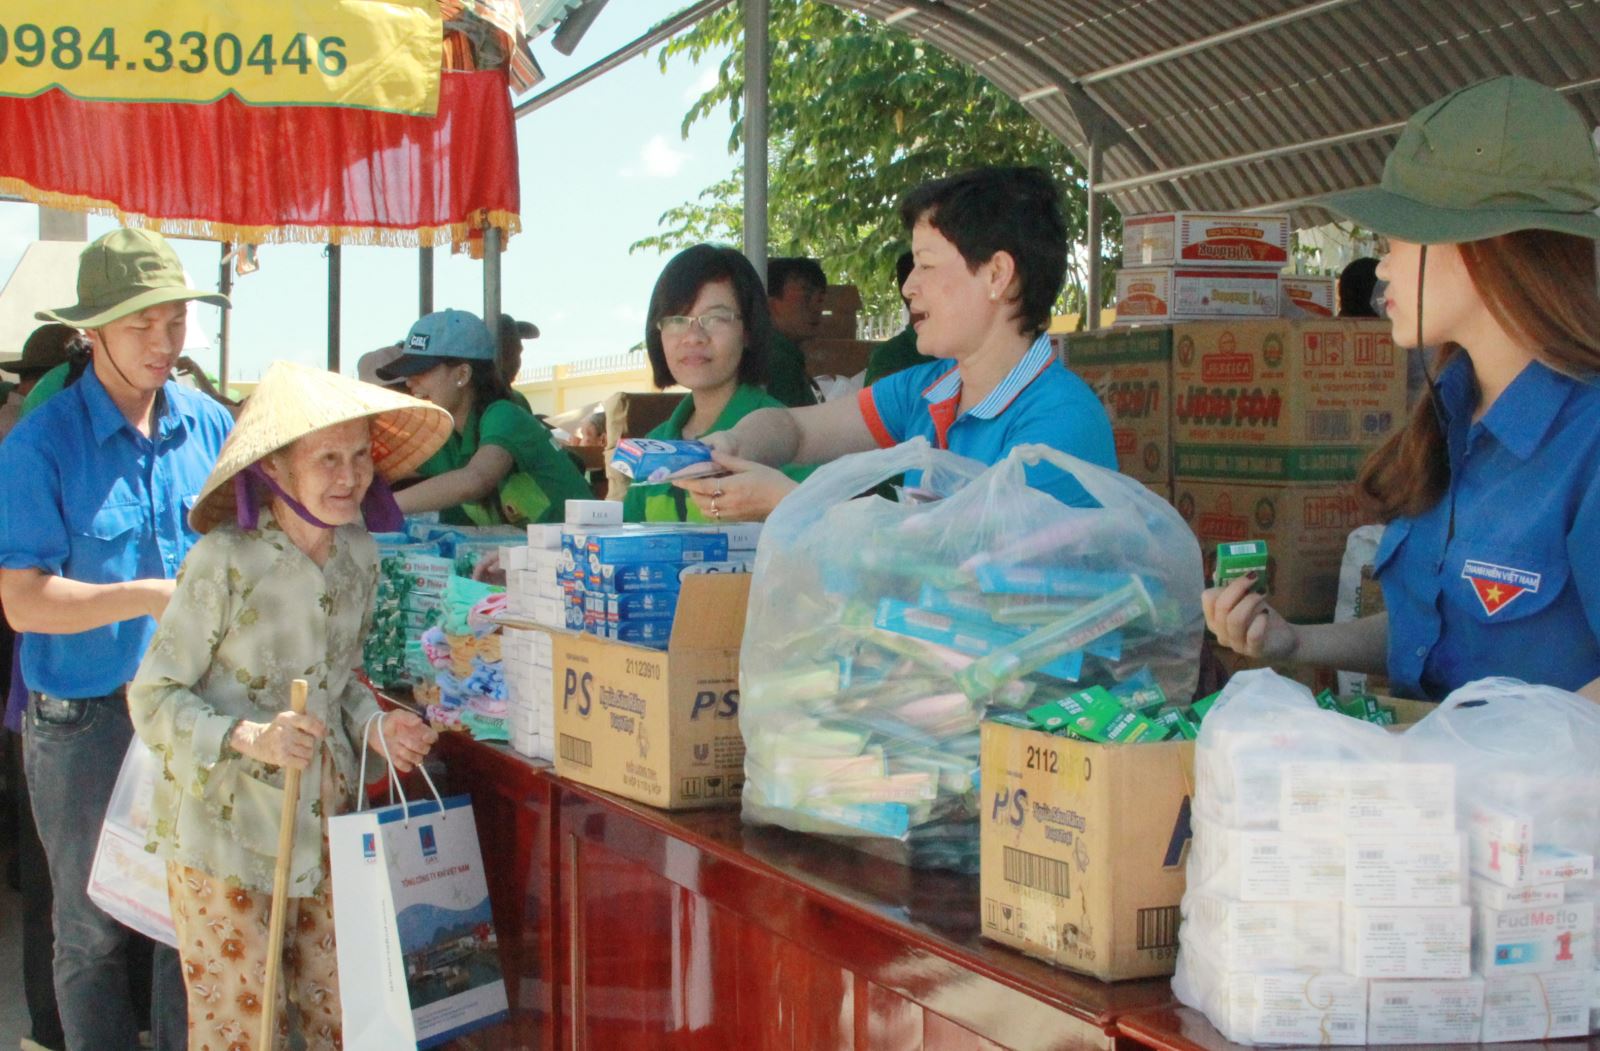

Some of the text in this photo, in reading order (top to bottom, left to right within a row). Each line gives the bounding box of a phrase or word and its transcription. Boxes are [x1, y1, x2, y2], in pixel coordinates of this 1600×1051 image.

[0, 24, 347, 77] 984.330446
[563, 667, 593, 716] PS
[691, 689, 740, 720] PS
[1497, 911, 1578, 928] FudMeflo
[1555, 931, 1574, 961] 1
